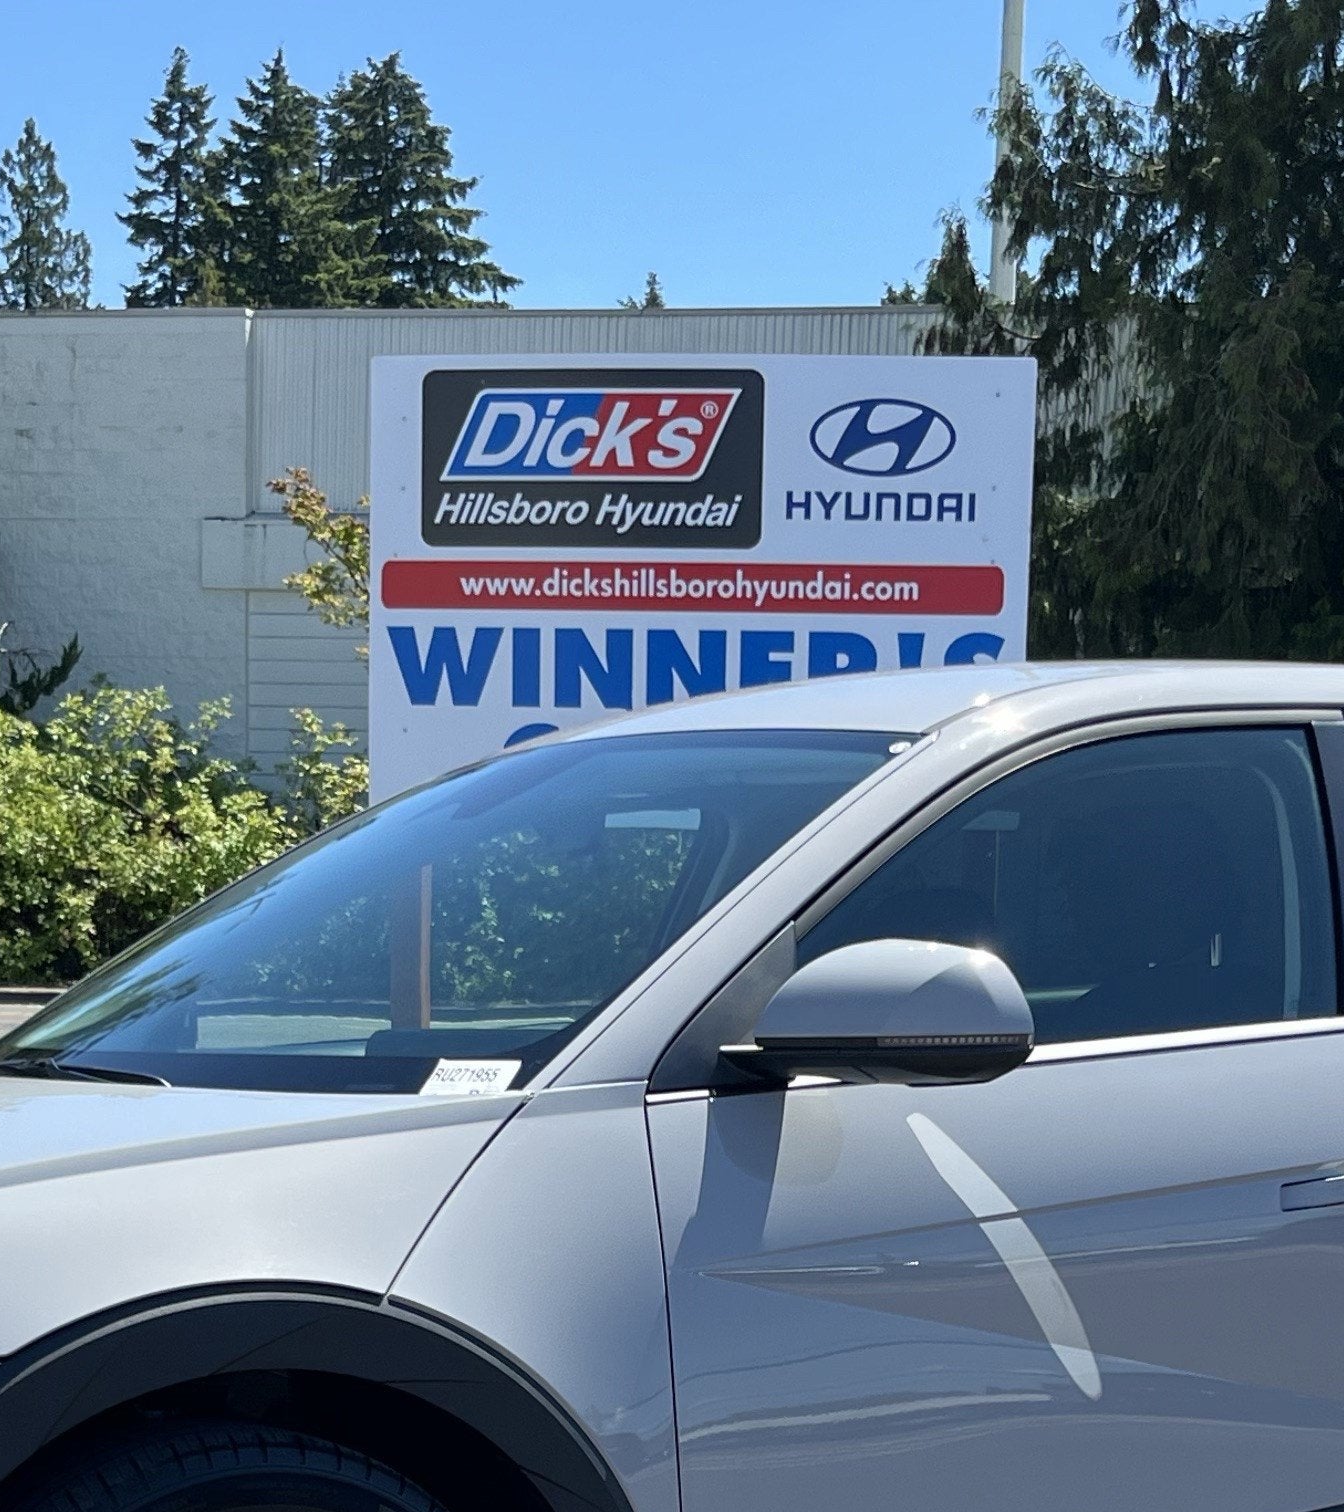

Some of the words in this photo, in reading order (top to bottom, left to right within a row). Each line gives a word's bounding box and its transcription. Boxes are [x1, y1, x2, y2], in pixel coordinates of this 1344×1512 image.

[434, 492, 590, 525] Hillsboro
[594, 493, 743, 534] Hyundai
[785, 491, 976, 523] HYUNDAI
[459, 568, 920, 607] www.dickshillsborohyundai.com
